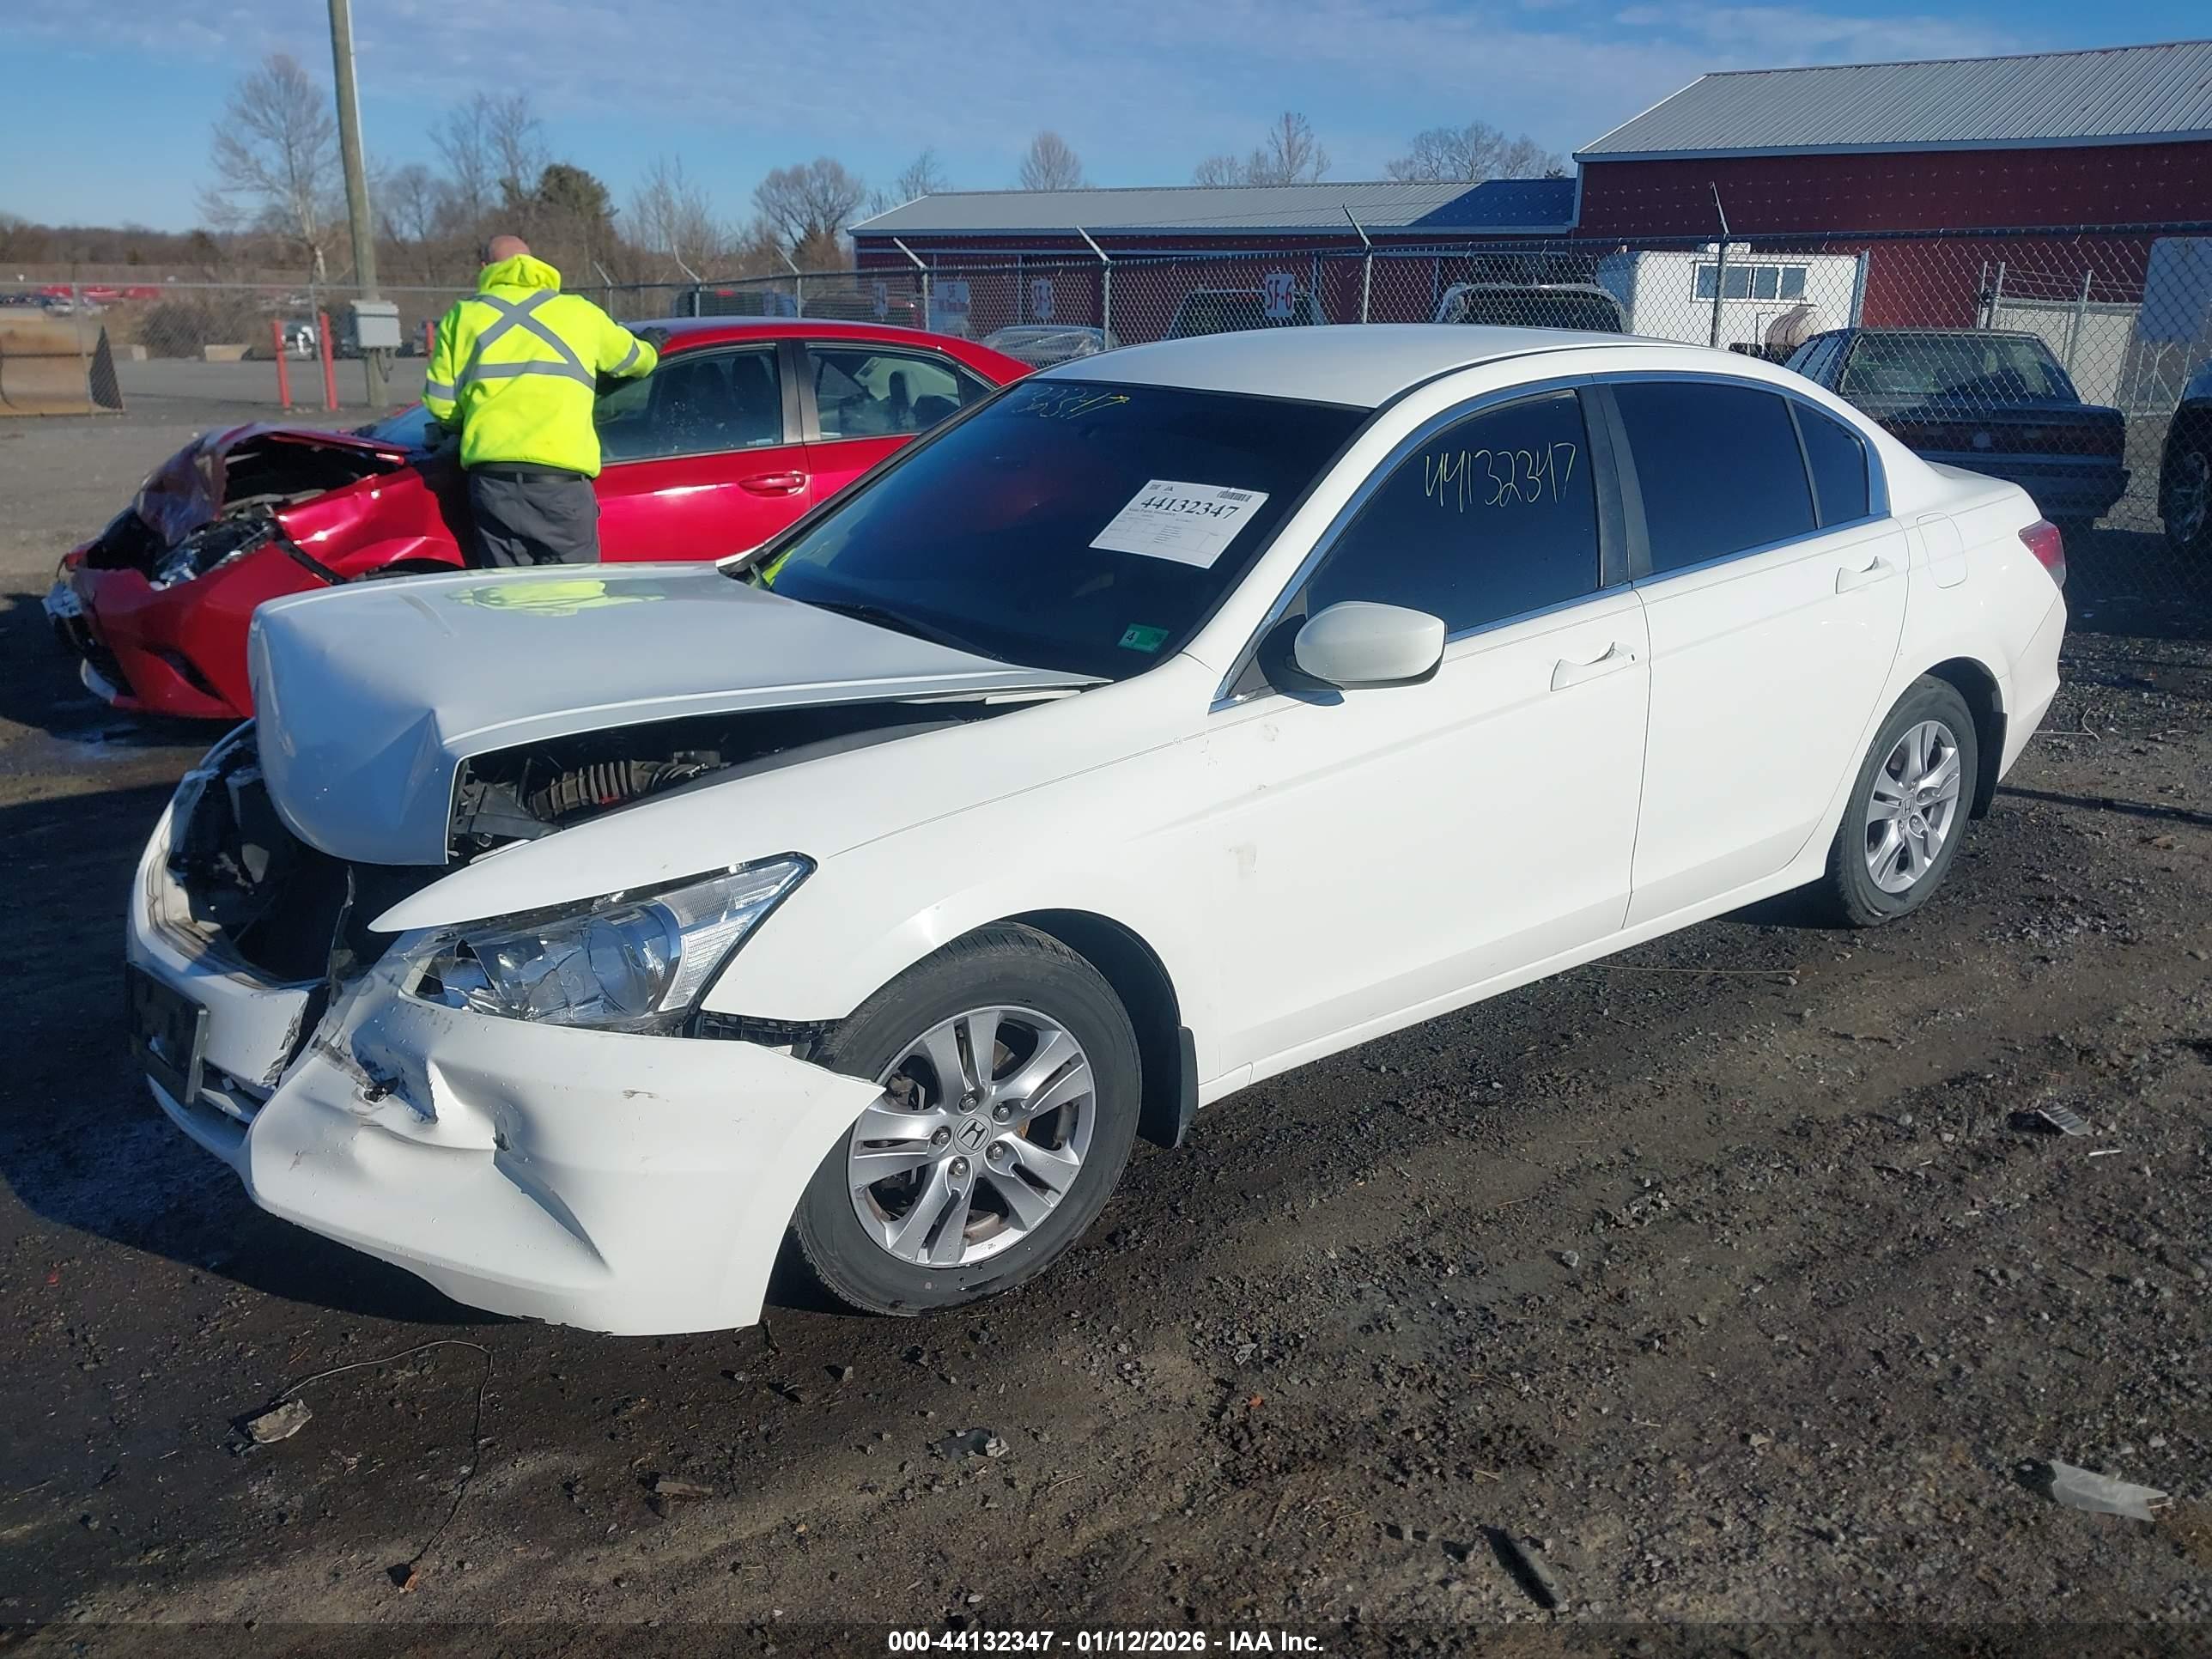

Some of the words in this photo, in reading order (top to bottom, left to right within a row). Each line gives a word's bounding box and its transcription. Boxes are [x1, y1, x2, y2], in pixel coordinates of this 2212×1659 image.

[1267, 279, 1292, 311] SF-6
[1425, 441, 1577, 514] 44132347
[1140, 495, 1241, 520] 44132347
